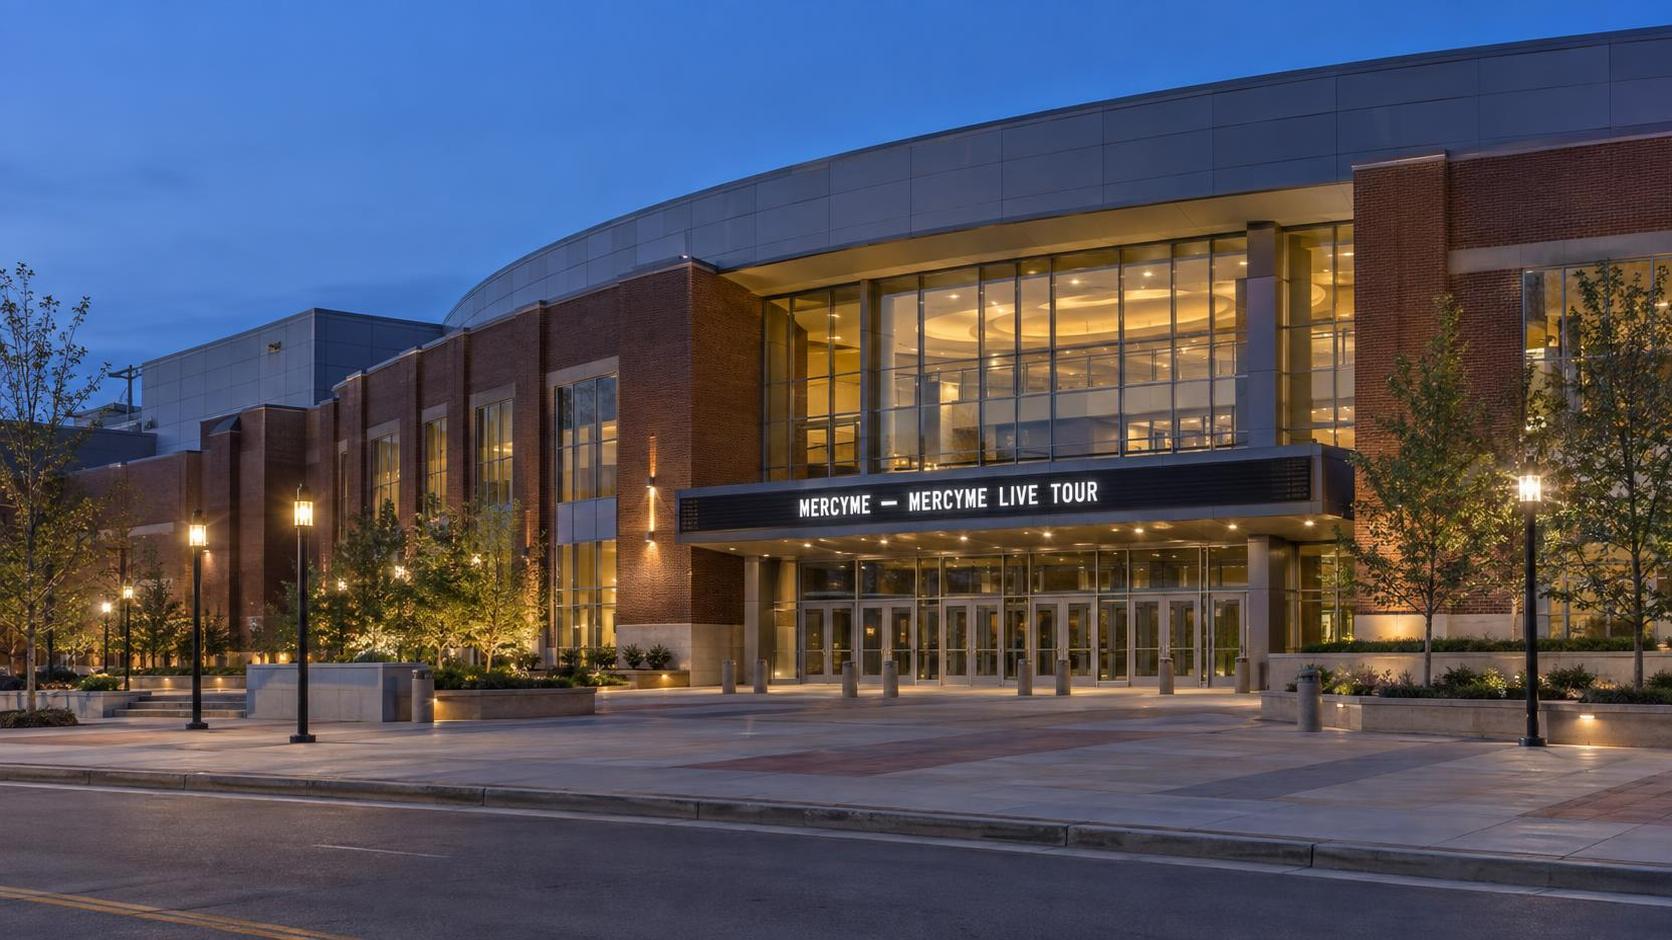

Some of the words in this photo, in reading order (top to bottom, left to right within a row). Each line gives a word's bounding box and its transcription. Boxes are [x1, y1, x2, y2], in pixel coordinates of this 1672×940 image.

[799, 494, 871, 519] MERCYME
[908, 487, 989, 513] MERCYME
[998, 484, 1039, 507] LIVE
[1050, 481, 1099, 504] TOUR
